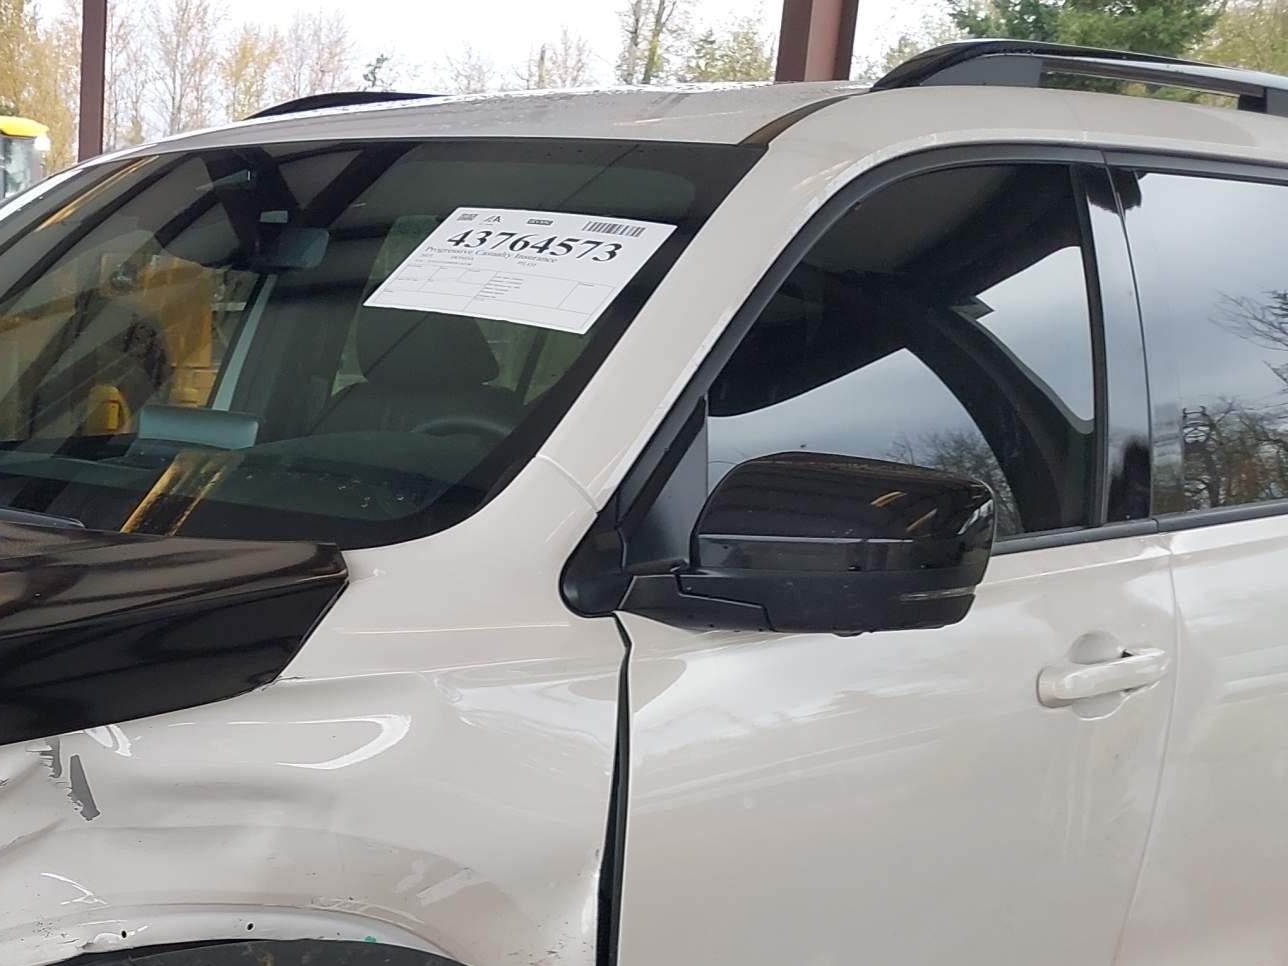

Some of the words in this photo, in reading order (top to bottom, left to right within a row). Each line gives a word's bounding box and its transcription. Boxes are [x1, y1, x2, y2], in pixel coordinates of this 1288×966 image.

[425, 246, 474, 256] Progressive
[475, 249, 511, 260] Casualty
[514, 253, 558, 264] Insurance
[447, 229, 623, 262] 43764573
